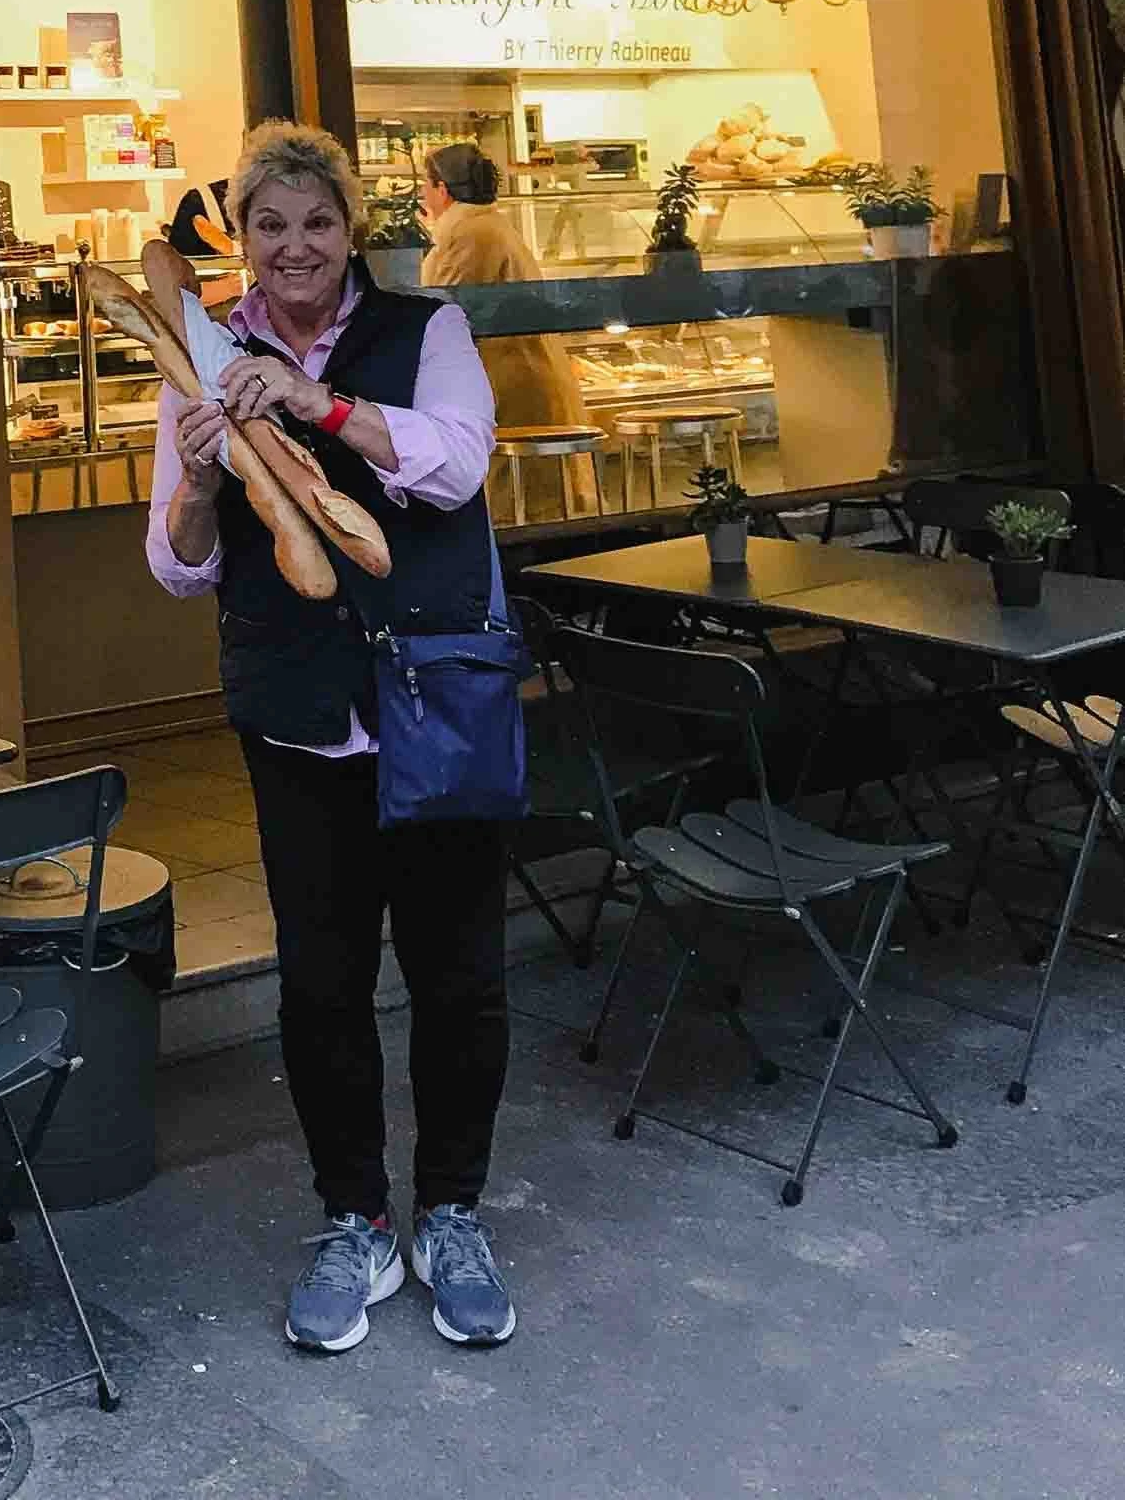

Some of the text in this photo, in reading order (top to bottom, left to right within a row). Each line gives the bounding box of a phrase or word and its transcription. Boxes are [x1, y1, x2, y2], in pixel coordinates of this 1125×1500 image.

[504, 38, 692, 66] BY Thierry Rabineau
